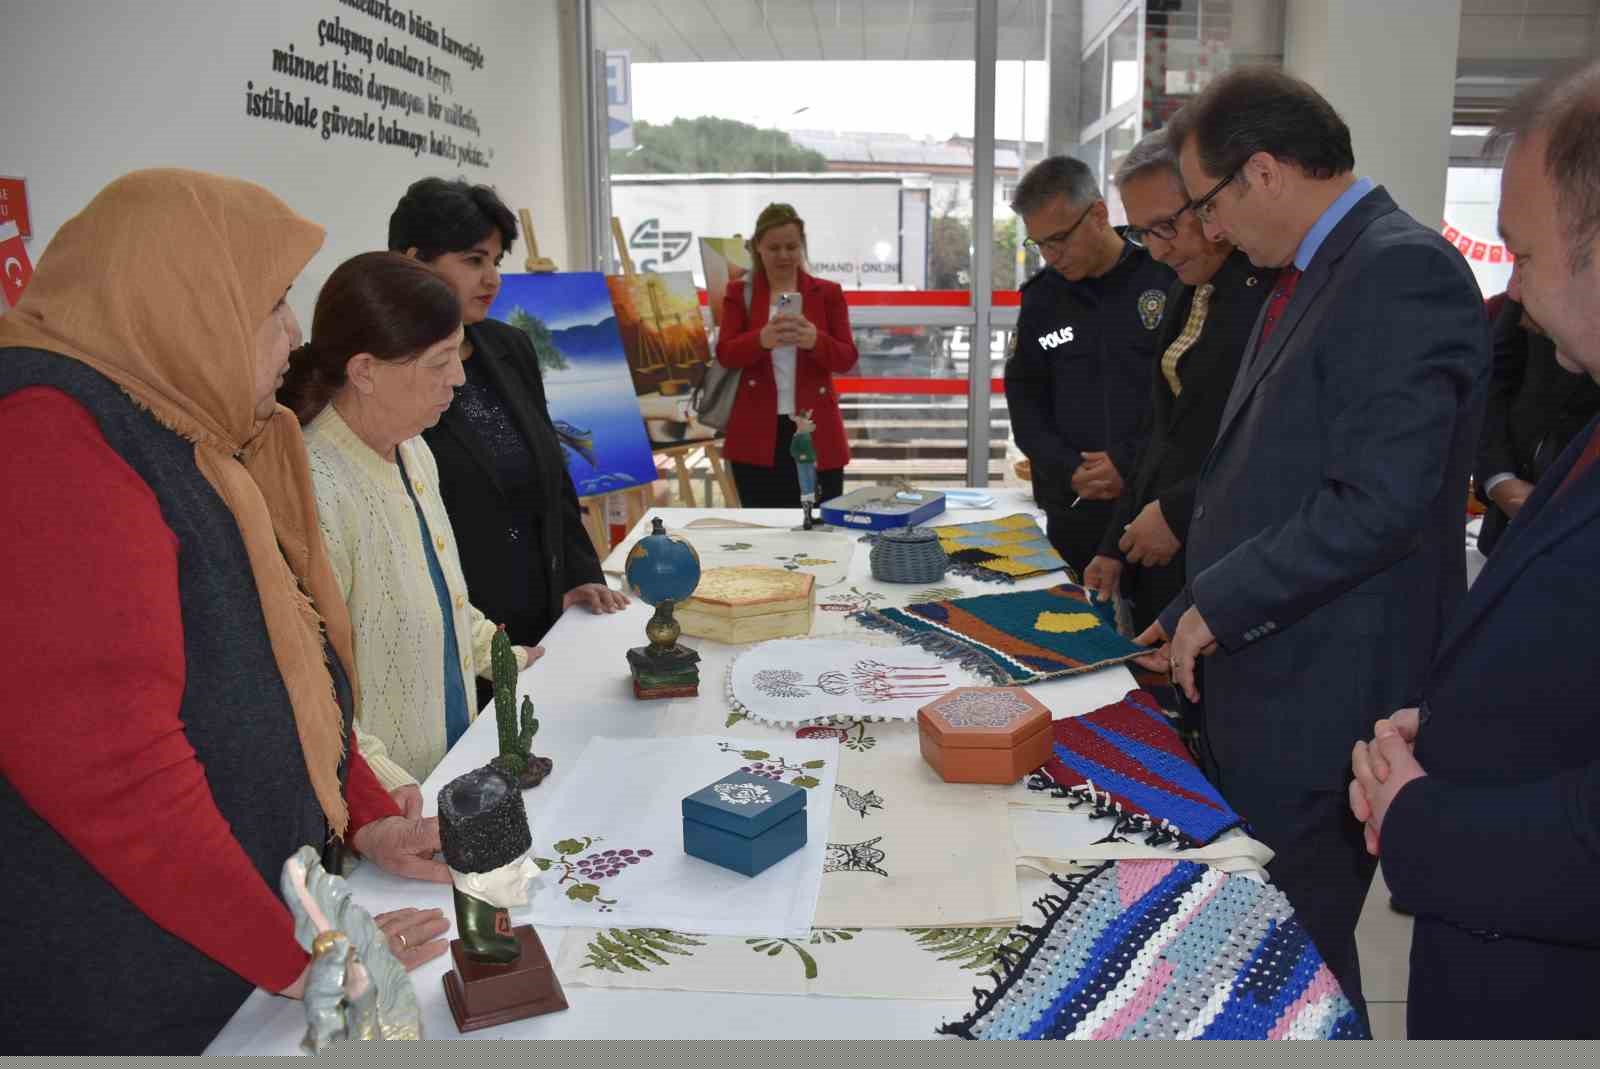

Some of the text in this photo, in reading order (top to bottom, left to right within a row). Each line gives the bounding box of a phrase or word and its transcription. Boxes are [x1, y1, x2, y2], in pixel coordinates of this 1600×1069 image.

[318, 16, 374, 63] çalışmış
[376, 37, 424, 77] olanlara
[246, 81, 318, 129] istikbale
[321, 105, 376, 140] güvenle
[272, 43, 330, 86] minnet
[332, 60, 364, 97] hissi
[367, 73, 425, 116] duymayan
[427, 93, 443, 122] bir
